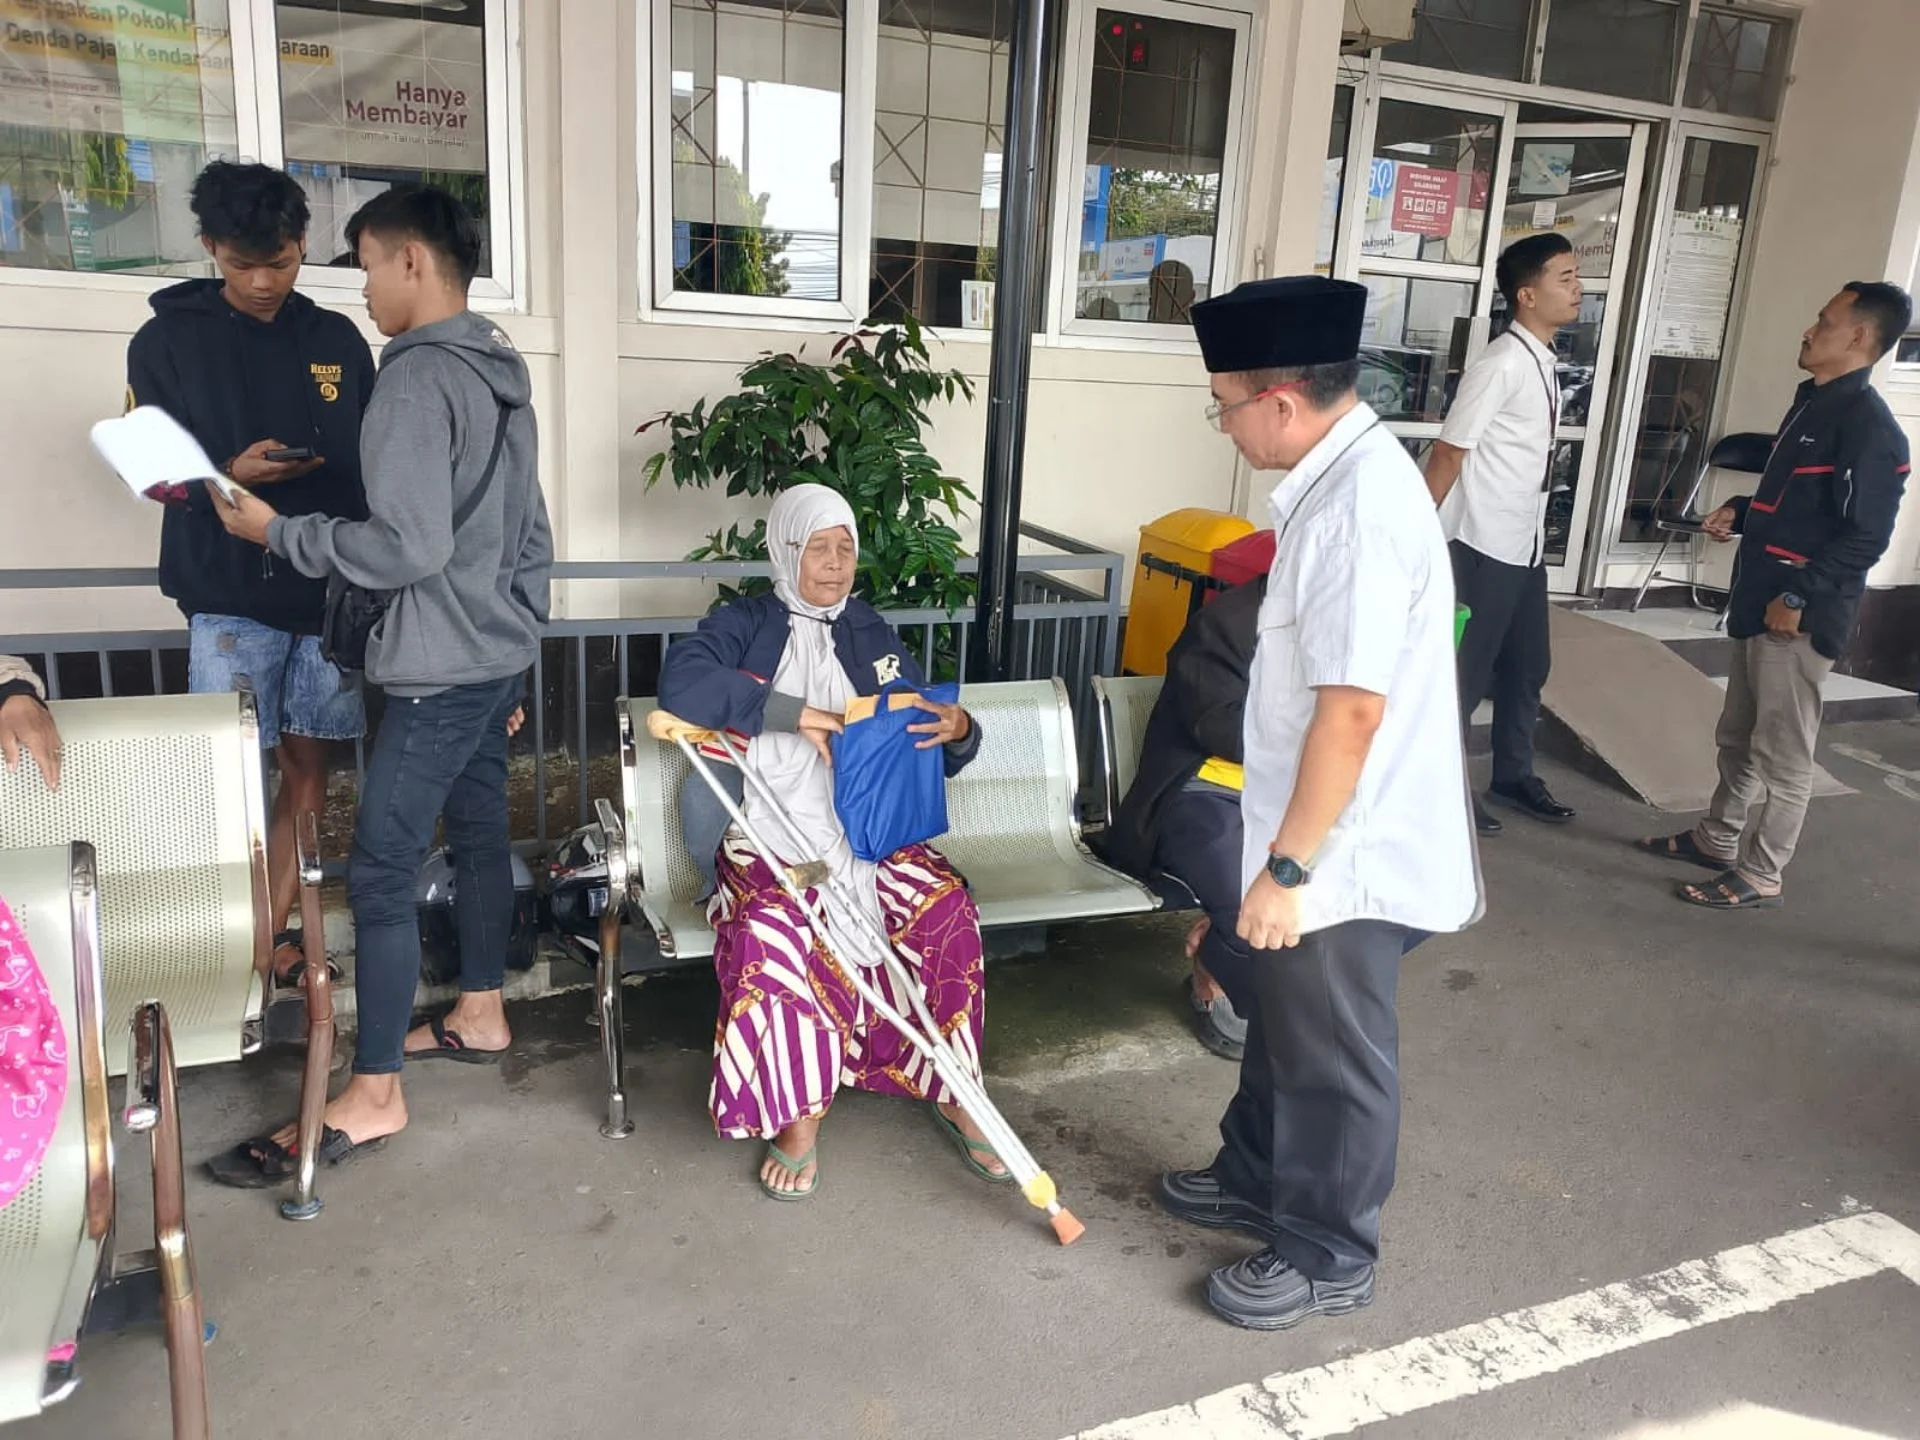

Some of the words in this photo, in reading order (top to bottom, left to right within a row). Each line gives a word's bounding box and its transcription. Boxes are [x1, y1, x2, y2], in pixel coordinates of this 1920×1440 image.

[117, 5, 177, 32] Pokok
[6, 22, 69, 48] Denda
[396, 80, 466, 110] Hanya
[346, 98, 467, 132] Membayar
